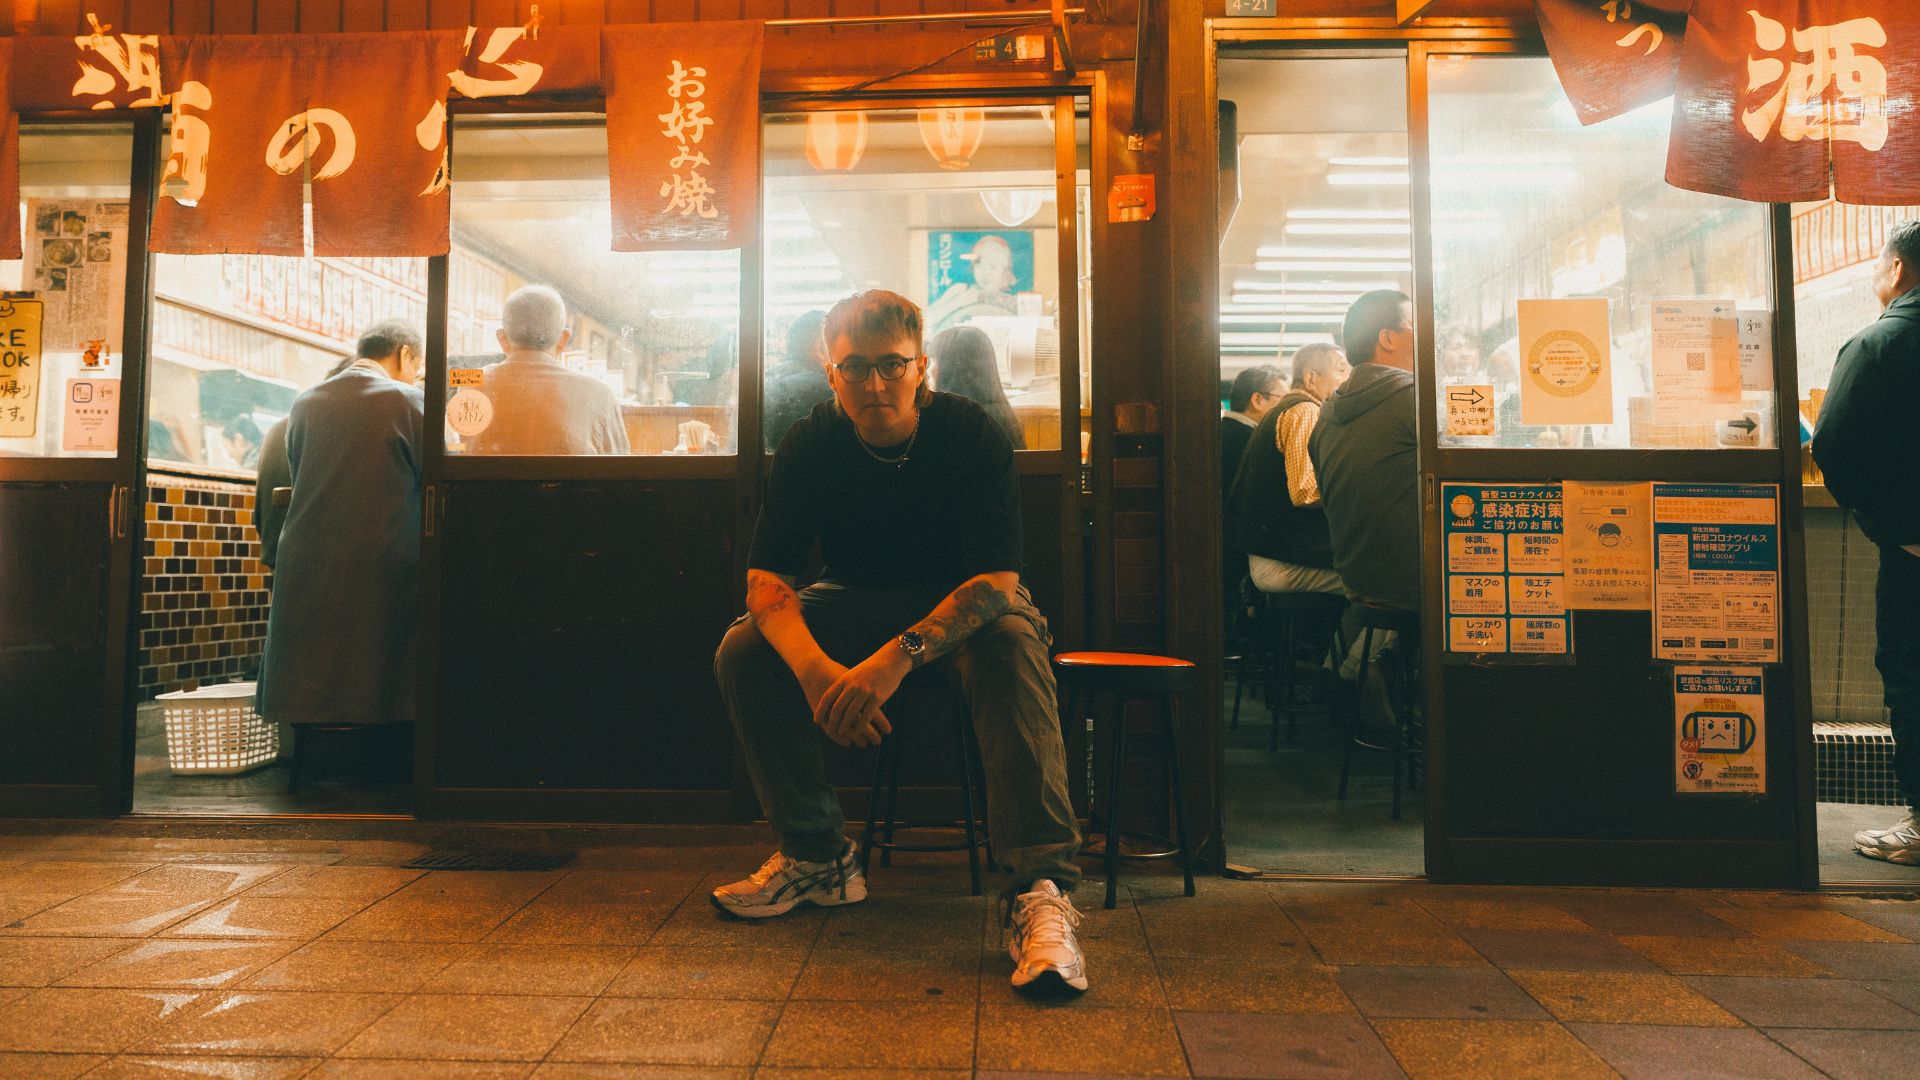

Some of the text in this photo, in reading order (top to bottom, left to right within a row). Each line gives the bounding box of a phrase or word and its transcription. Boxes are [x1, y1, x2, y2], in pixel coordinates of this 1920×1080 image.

[1233, 0, 1267, 11] 4-21
[1741, 10, 1889, 152] 酒
[658, 59, 719, 219] お好み焼
[0, 405, 25, 422] す。
[1481, 490, 1562, 499] 新型コロナウイルス
[1583, 489, 1632, 497] お客様へお願い
[1482, 502, 1563, 519] 感染症対策
[1482, 519, 1563, 531] ご協力のお願い
[1464, 535, 1490, 545] 体調に
[1523, 535, 1559, 546] 短時間の
[1692, 533, 1768, 543] 新型コロナウイルス
[1464, 545, 1499, 556] ご留意を
[1523, 546, 1550, 556] 滞在で
[1692, 543, 1751, 552] 接触確認アプリ
[1572, 567, 1647, 576] 風邪の症状等がある方は
[1465, 578, 1500, 587] マスクの
[1525, 578, 1553, 588] 咳エチ
[1573, 579, 1649, 588] ご入店をお控え下さい。
[1465, 588, 1483, 598] 着用
[1525, 589, 1552, 598] ケット
[1466, 620, 1502, 629] しっかり
[1526, 620, 1561, 629] 座席数の
[1466, 630, 1494, 640] 手洗い
[1526, 630, 1545, 640] 削減
[1680, 676, 1757, 686] 飲食店の感染リスク低減に
